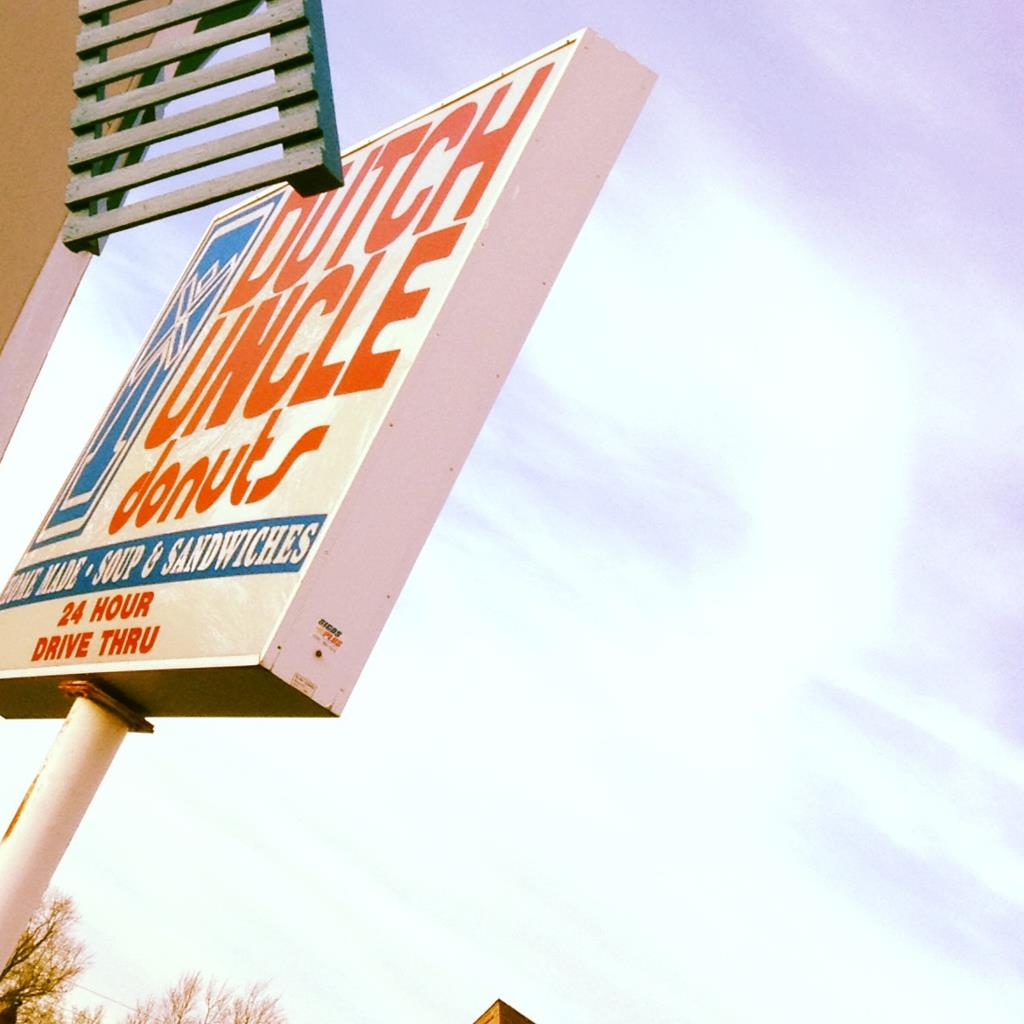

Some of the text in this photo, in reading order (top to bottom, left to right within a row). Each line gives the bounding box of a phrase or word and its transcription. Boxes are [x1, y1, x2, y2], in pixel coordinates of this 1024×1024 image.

[220, 62, 556, 313] DUTCH
[144, 222, 467, 450] UNCLE
[108, 408, 330, 535] donuts
[35, 556, 86, 596] MADE
[92, 544, 146, 586] SOUP
[141, 540, 164, 578] &
[160, 523, 320, 576] SANDWICHES
[57, 591, 155, 627] 24 HOUR
[31, 626, 160, 662] DRIVE THRU
